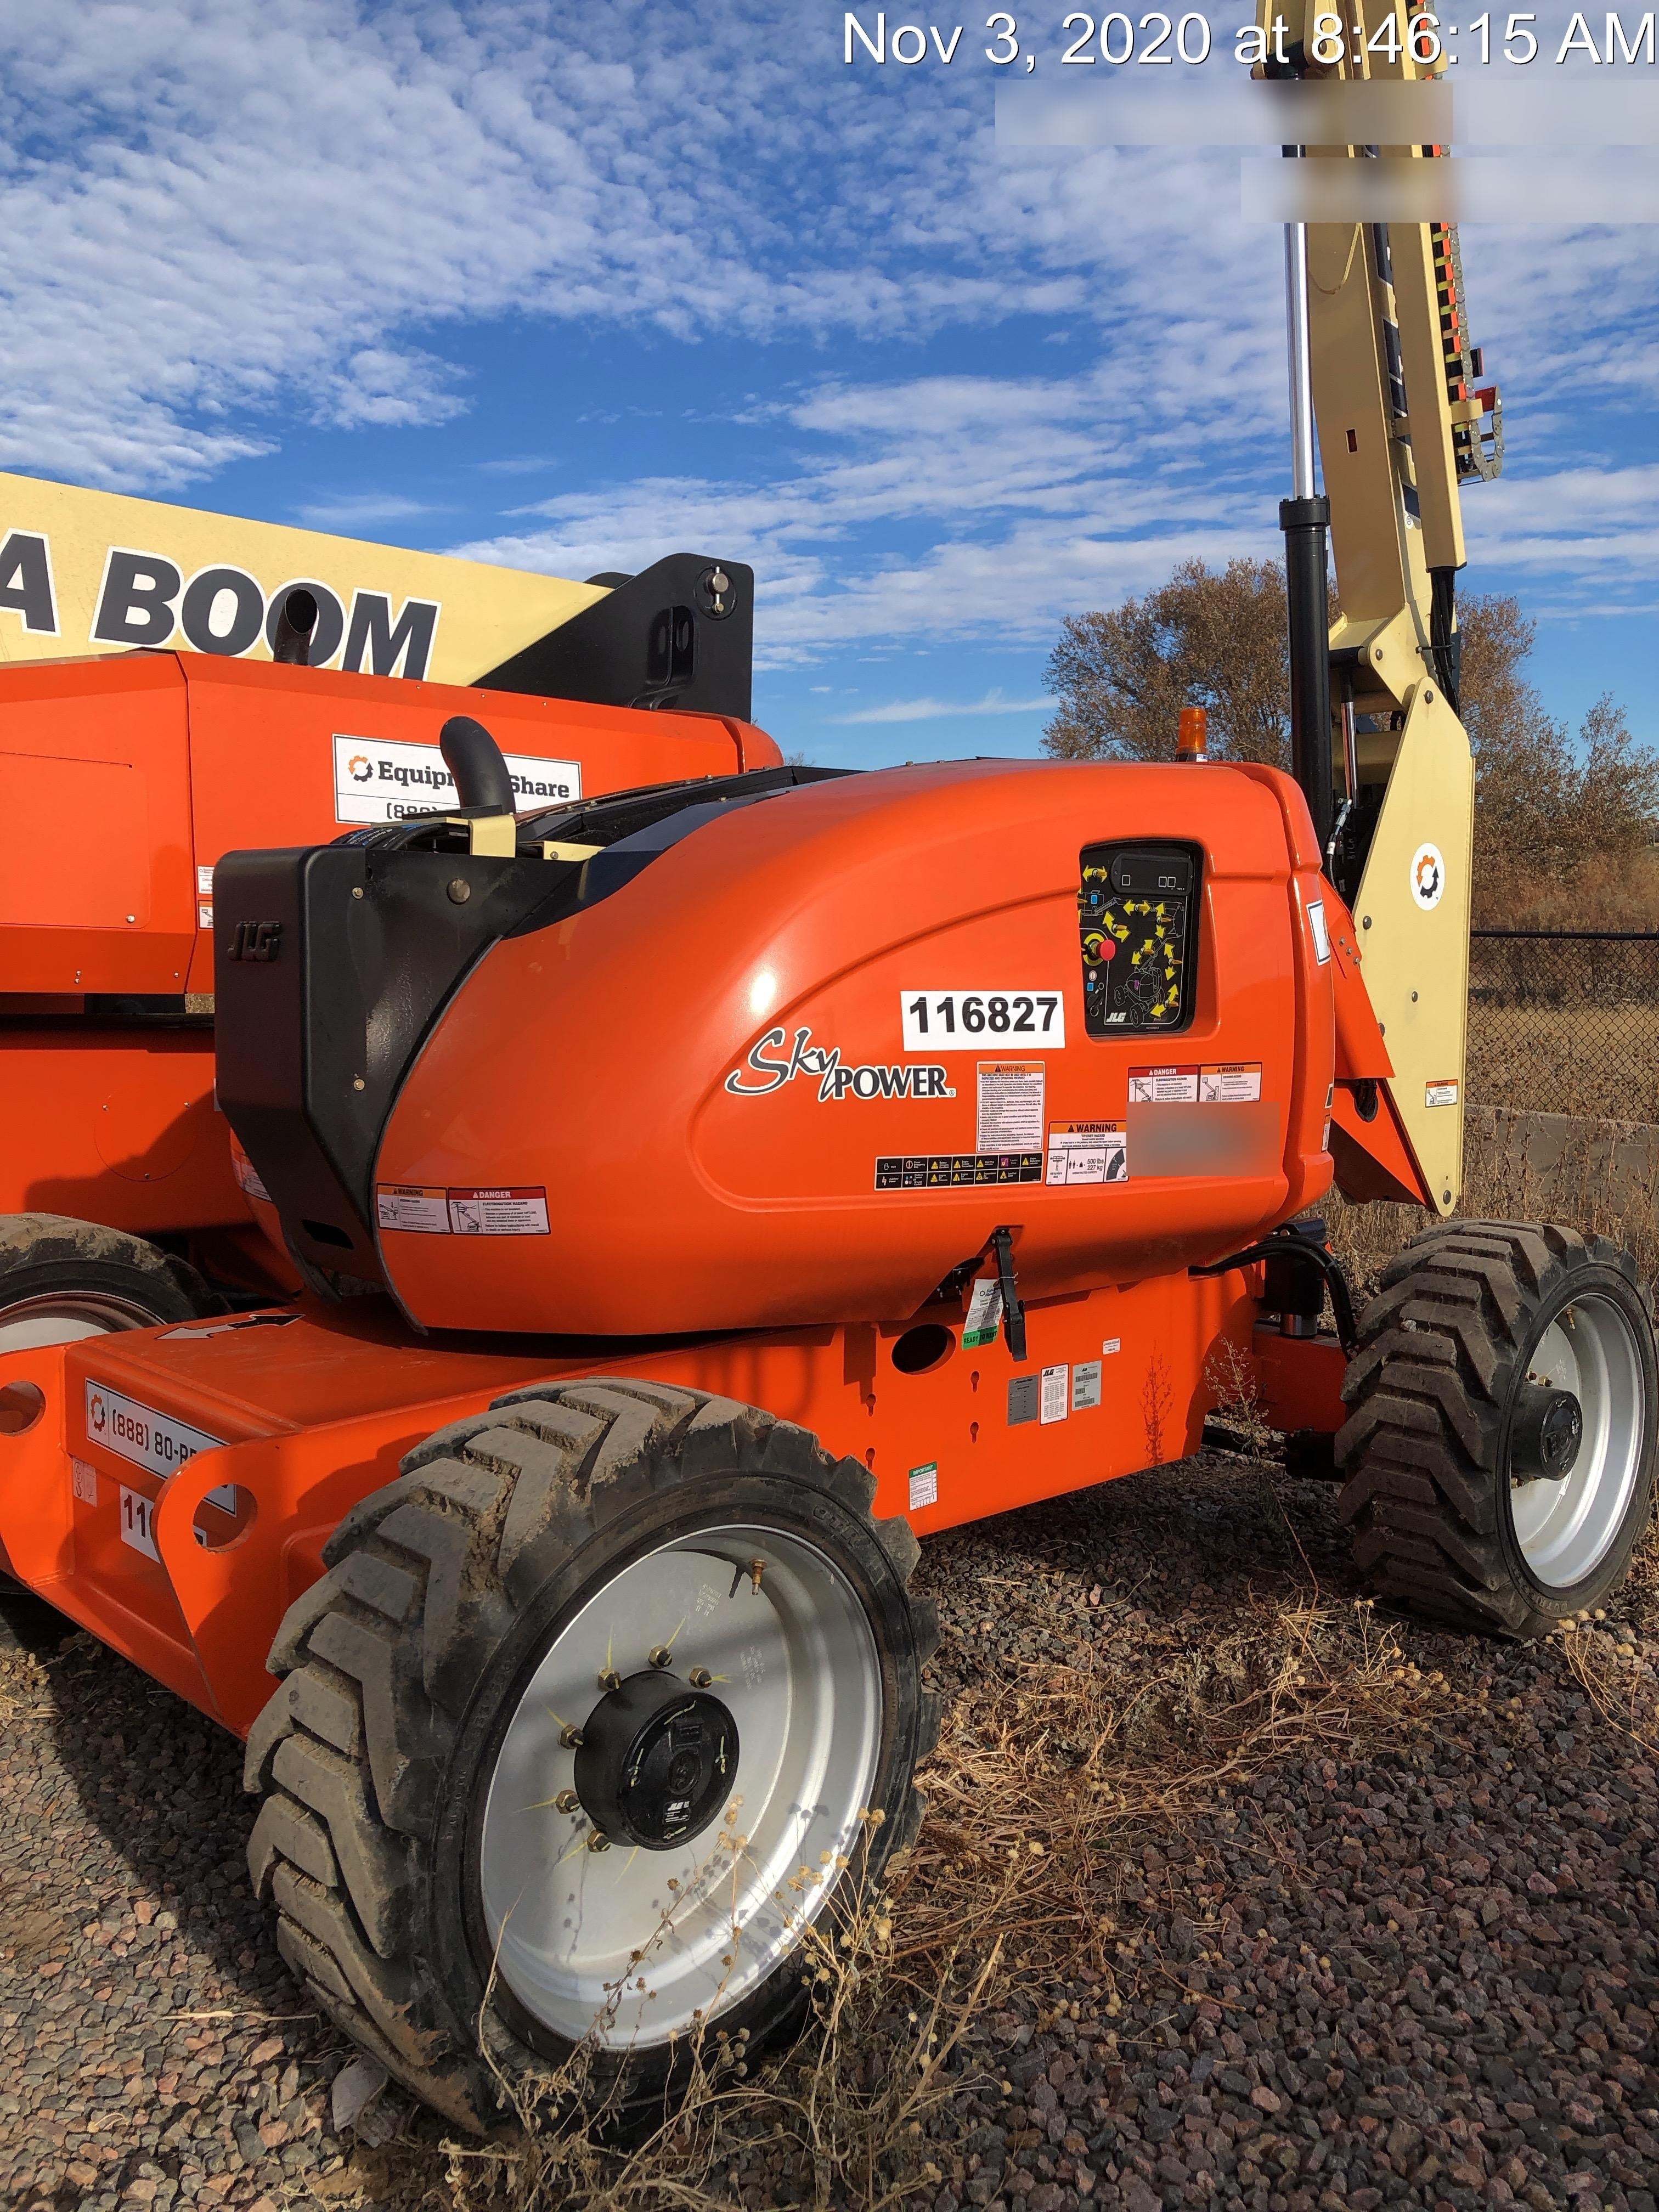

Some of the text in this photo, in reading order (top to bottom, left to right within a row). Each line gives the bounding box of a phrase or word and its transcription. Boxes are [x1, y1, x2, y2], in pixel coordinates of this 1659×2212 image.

[93, 550, 438, 681] BOOM
[227, 921, 280, 962] JLG
[910, 996, 1058, 1033] 116827
[1106, 1012, 1126, 1023] JLG
[727, 1027, 947, 1100] Sky POWER
[1076, 1123, 1117, 1132] WARNING
[479, 1191, 511, 1199] DANGER
[963, 1335, 979, 1345] READY
[1043, 1368, 1055, 1377] JLG
[112, 1408, 149, 1451] (888)
[913, 1465, 933, 1475] IMPORTANT
